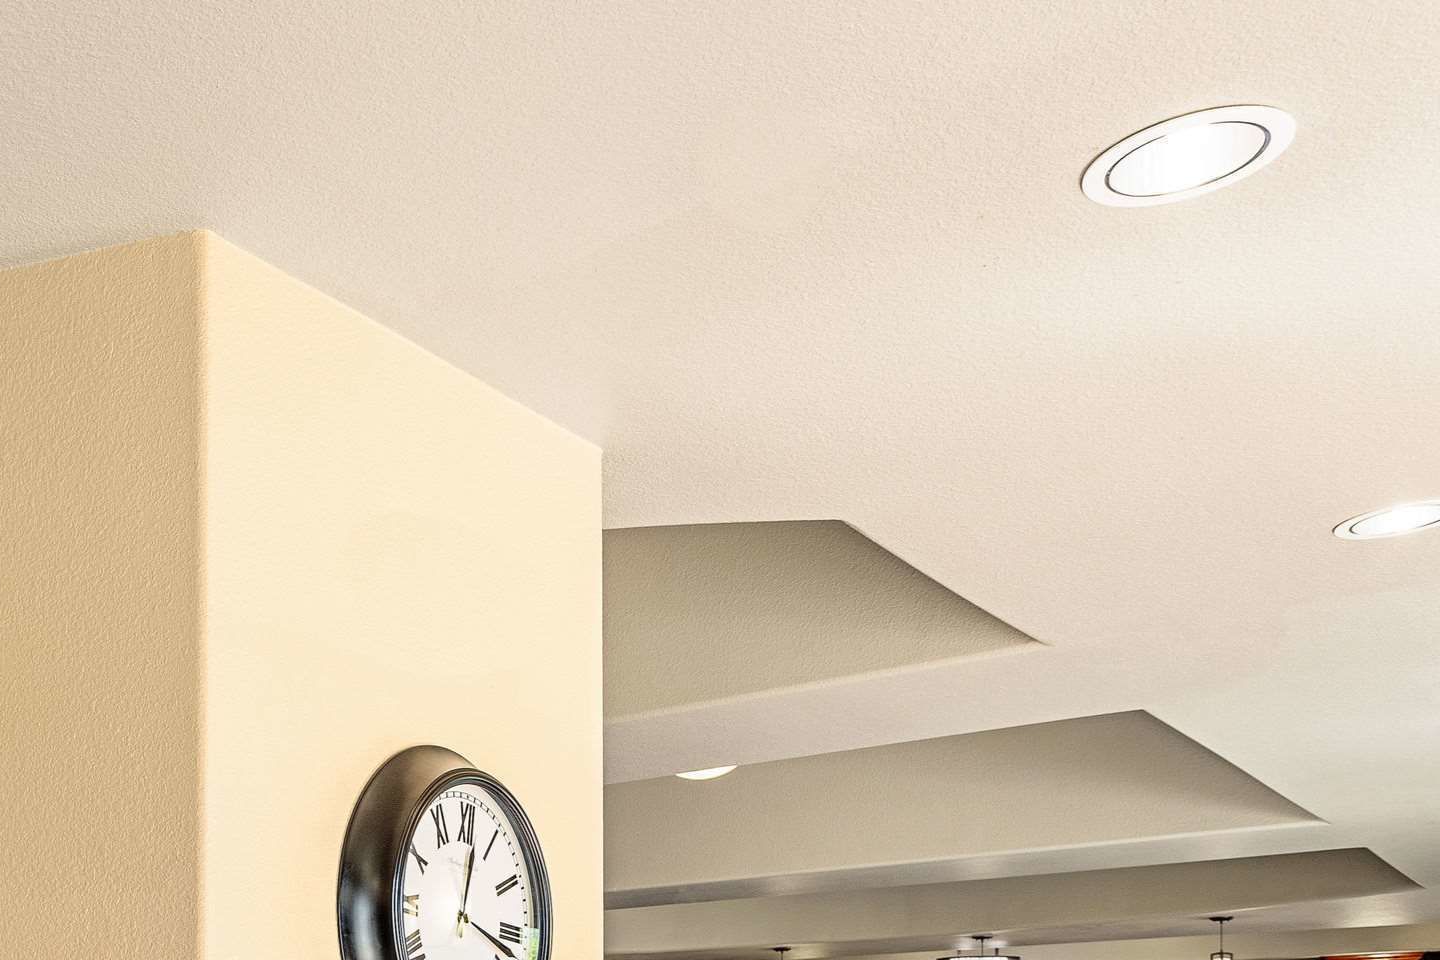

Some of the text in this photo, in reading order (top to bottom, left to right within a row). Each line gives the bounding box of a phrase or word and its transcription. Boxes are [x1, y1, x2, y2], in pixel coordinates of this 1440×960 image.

[429, 803, 450, 849] XI
[457, 801, 476, 846] XII
[495, 874, 519, 897] II
[499, 921, 522, 945] III
